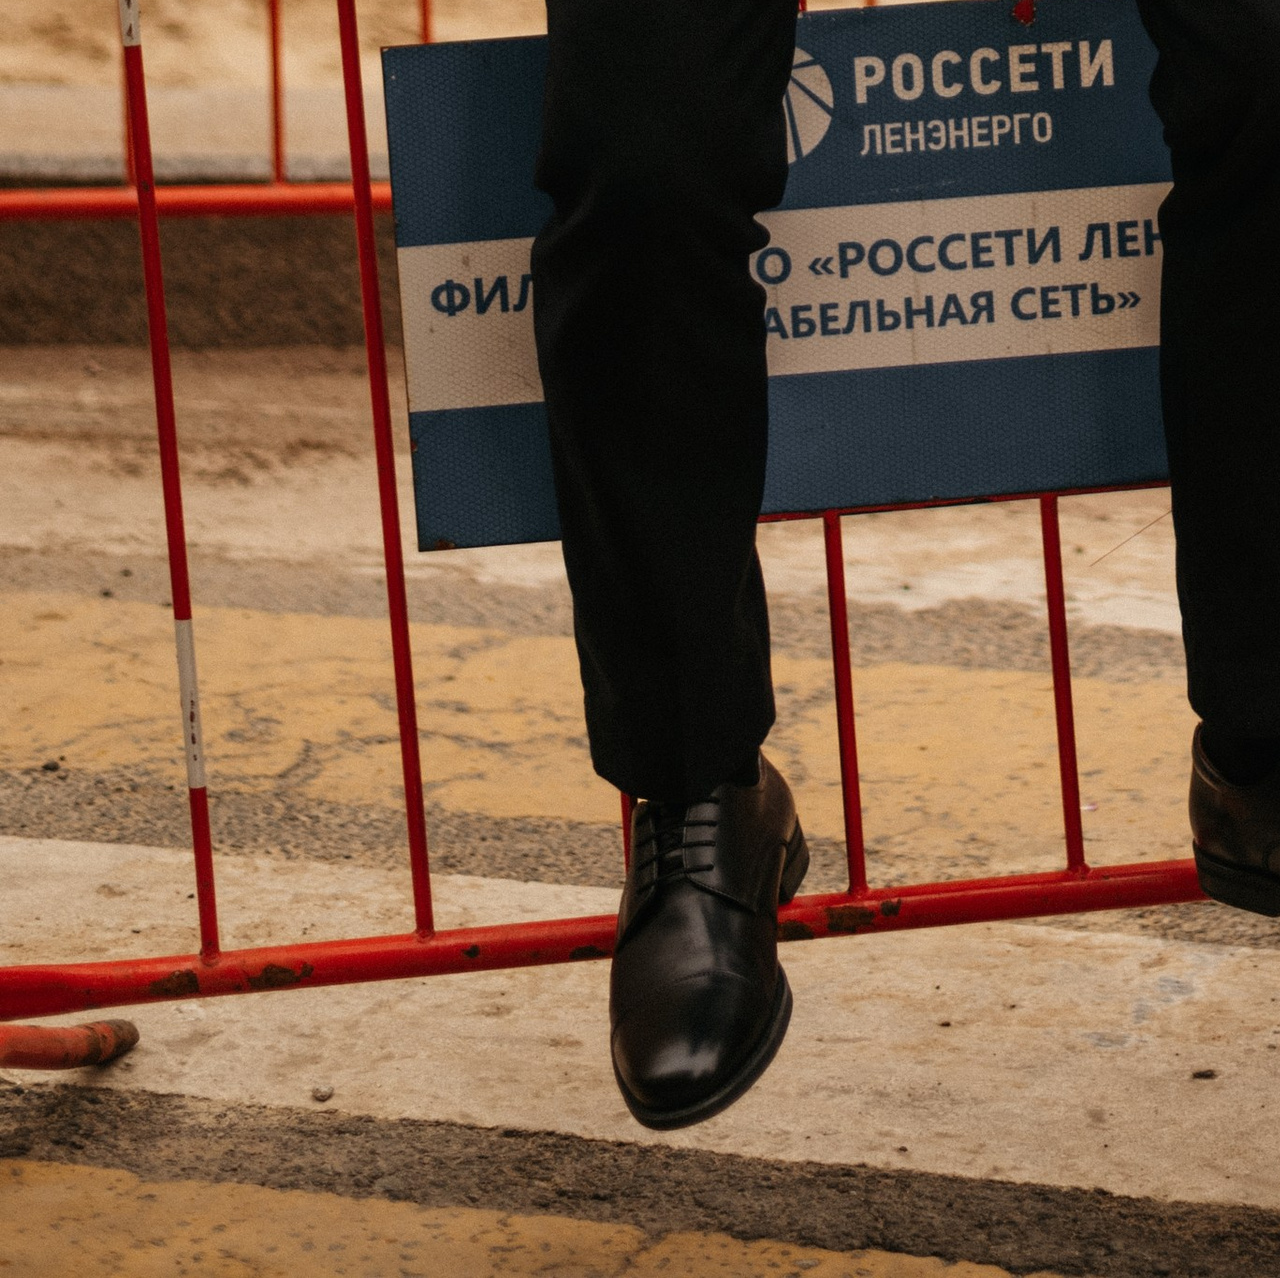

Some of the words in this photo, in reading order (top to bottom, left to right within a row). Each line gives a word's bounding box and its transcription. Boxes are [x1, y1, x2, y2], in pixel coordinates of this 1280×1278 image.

[854, 39, 1115, 104] РОССЕТИ
[860, 111, 1053, 156] ЛЕНЭНЕРГО
[430, 273, 533, 317] ФИЛ
[808, 226, 1061, 279] «РОССЕТИ
[1078, 218, 1163, 261] ЛЕН
[765, 290, 995, 339] АБЕЛЬНАЯ
[1010, 282, 1142, 321] СЕТЬ»
